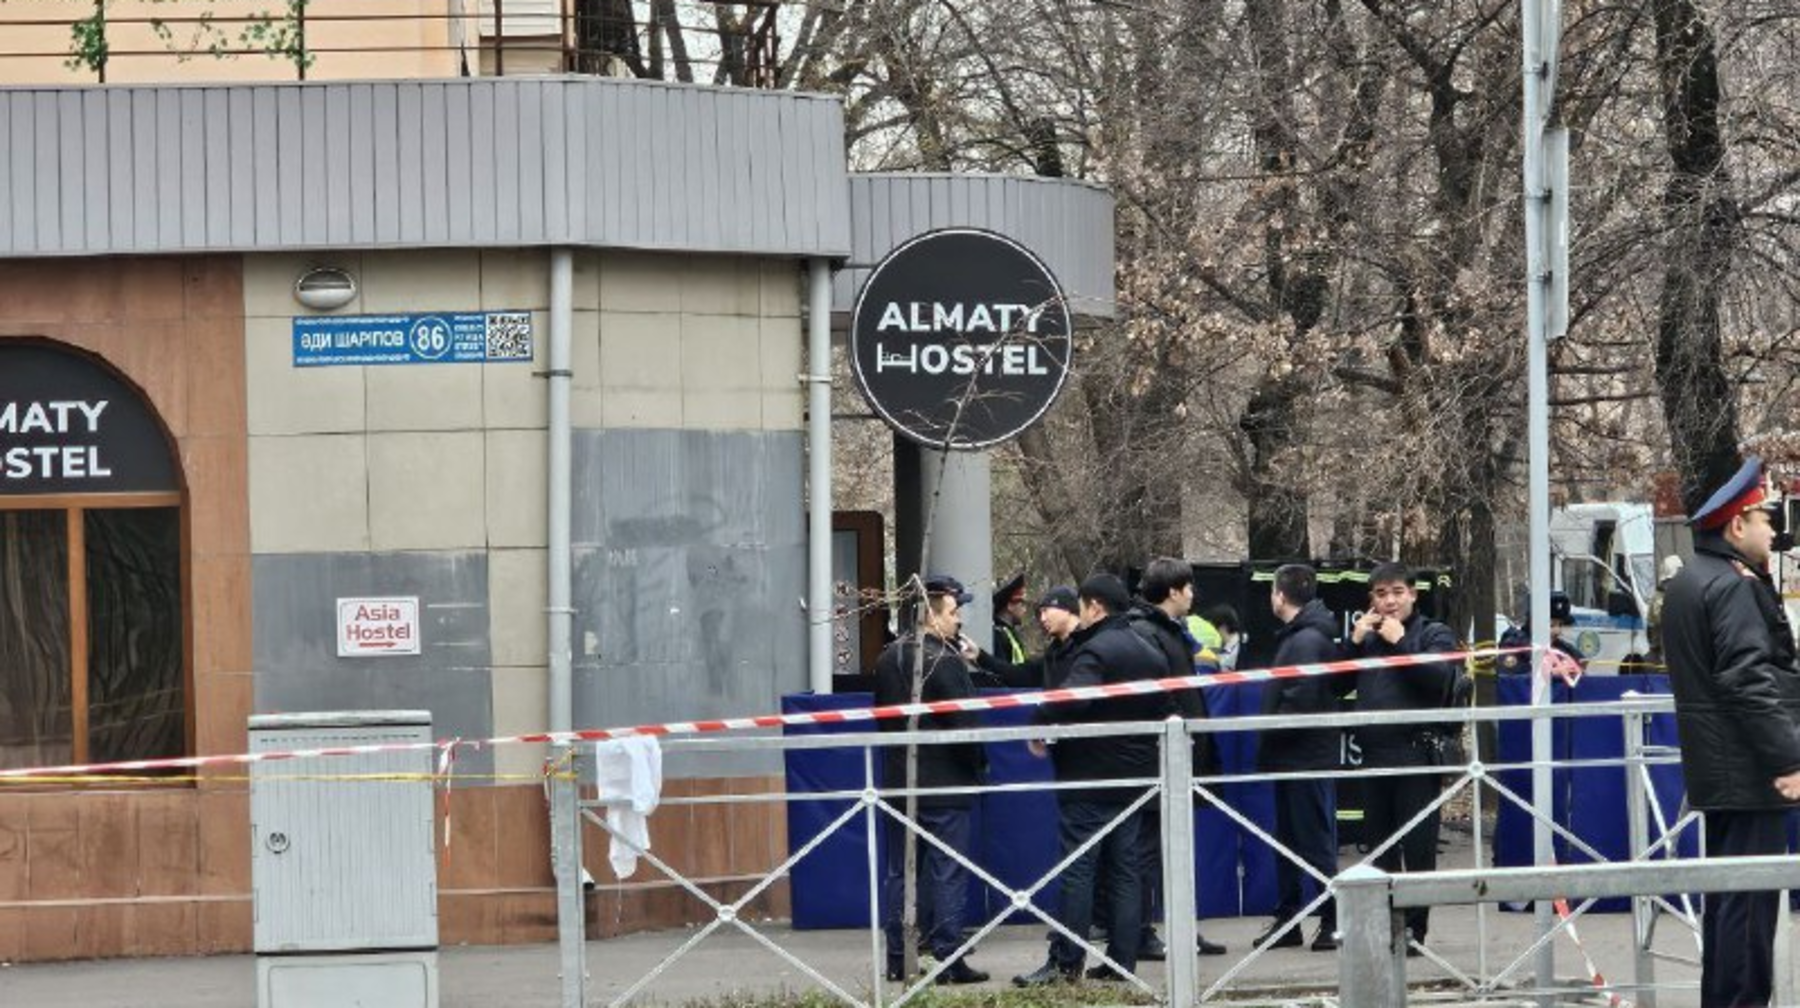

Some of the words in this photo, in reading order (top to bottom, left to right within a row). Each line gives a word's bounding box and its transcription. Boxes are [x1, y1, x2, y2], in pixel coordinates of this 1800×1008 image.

[877, 302, 1045, 333] ALMATY
[417, 325, 445, 350] 86
[876, 342, 1048, 375] HOSTEL
[0, 446, 112, 479] STEL
[355, 604, 400, 621] Asia
[346, 623, 411, 640] Hostel
